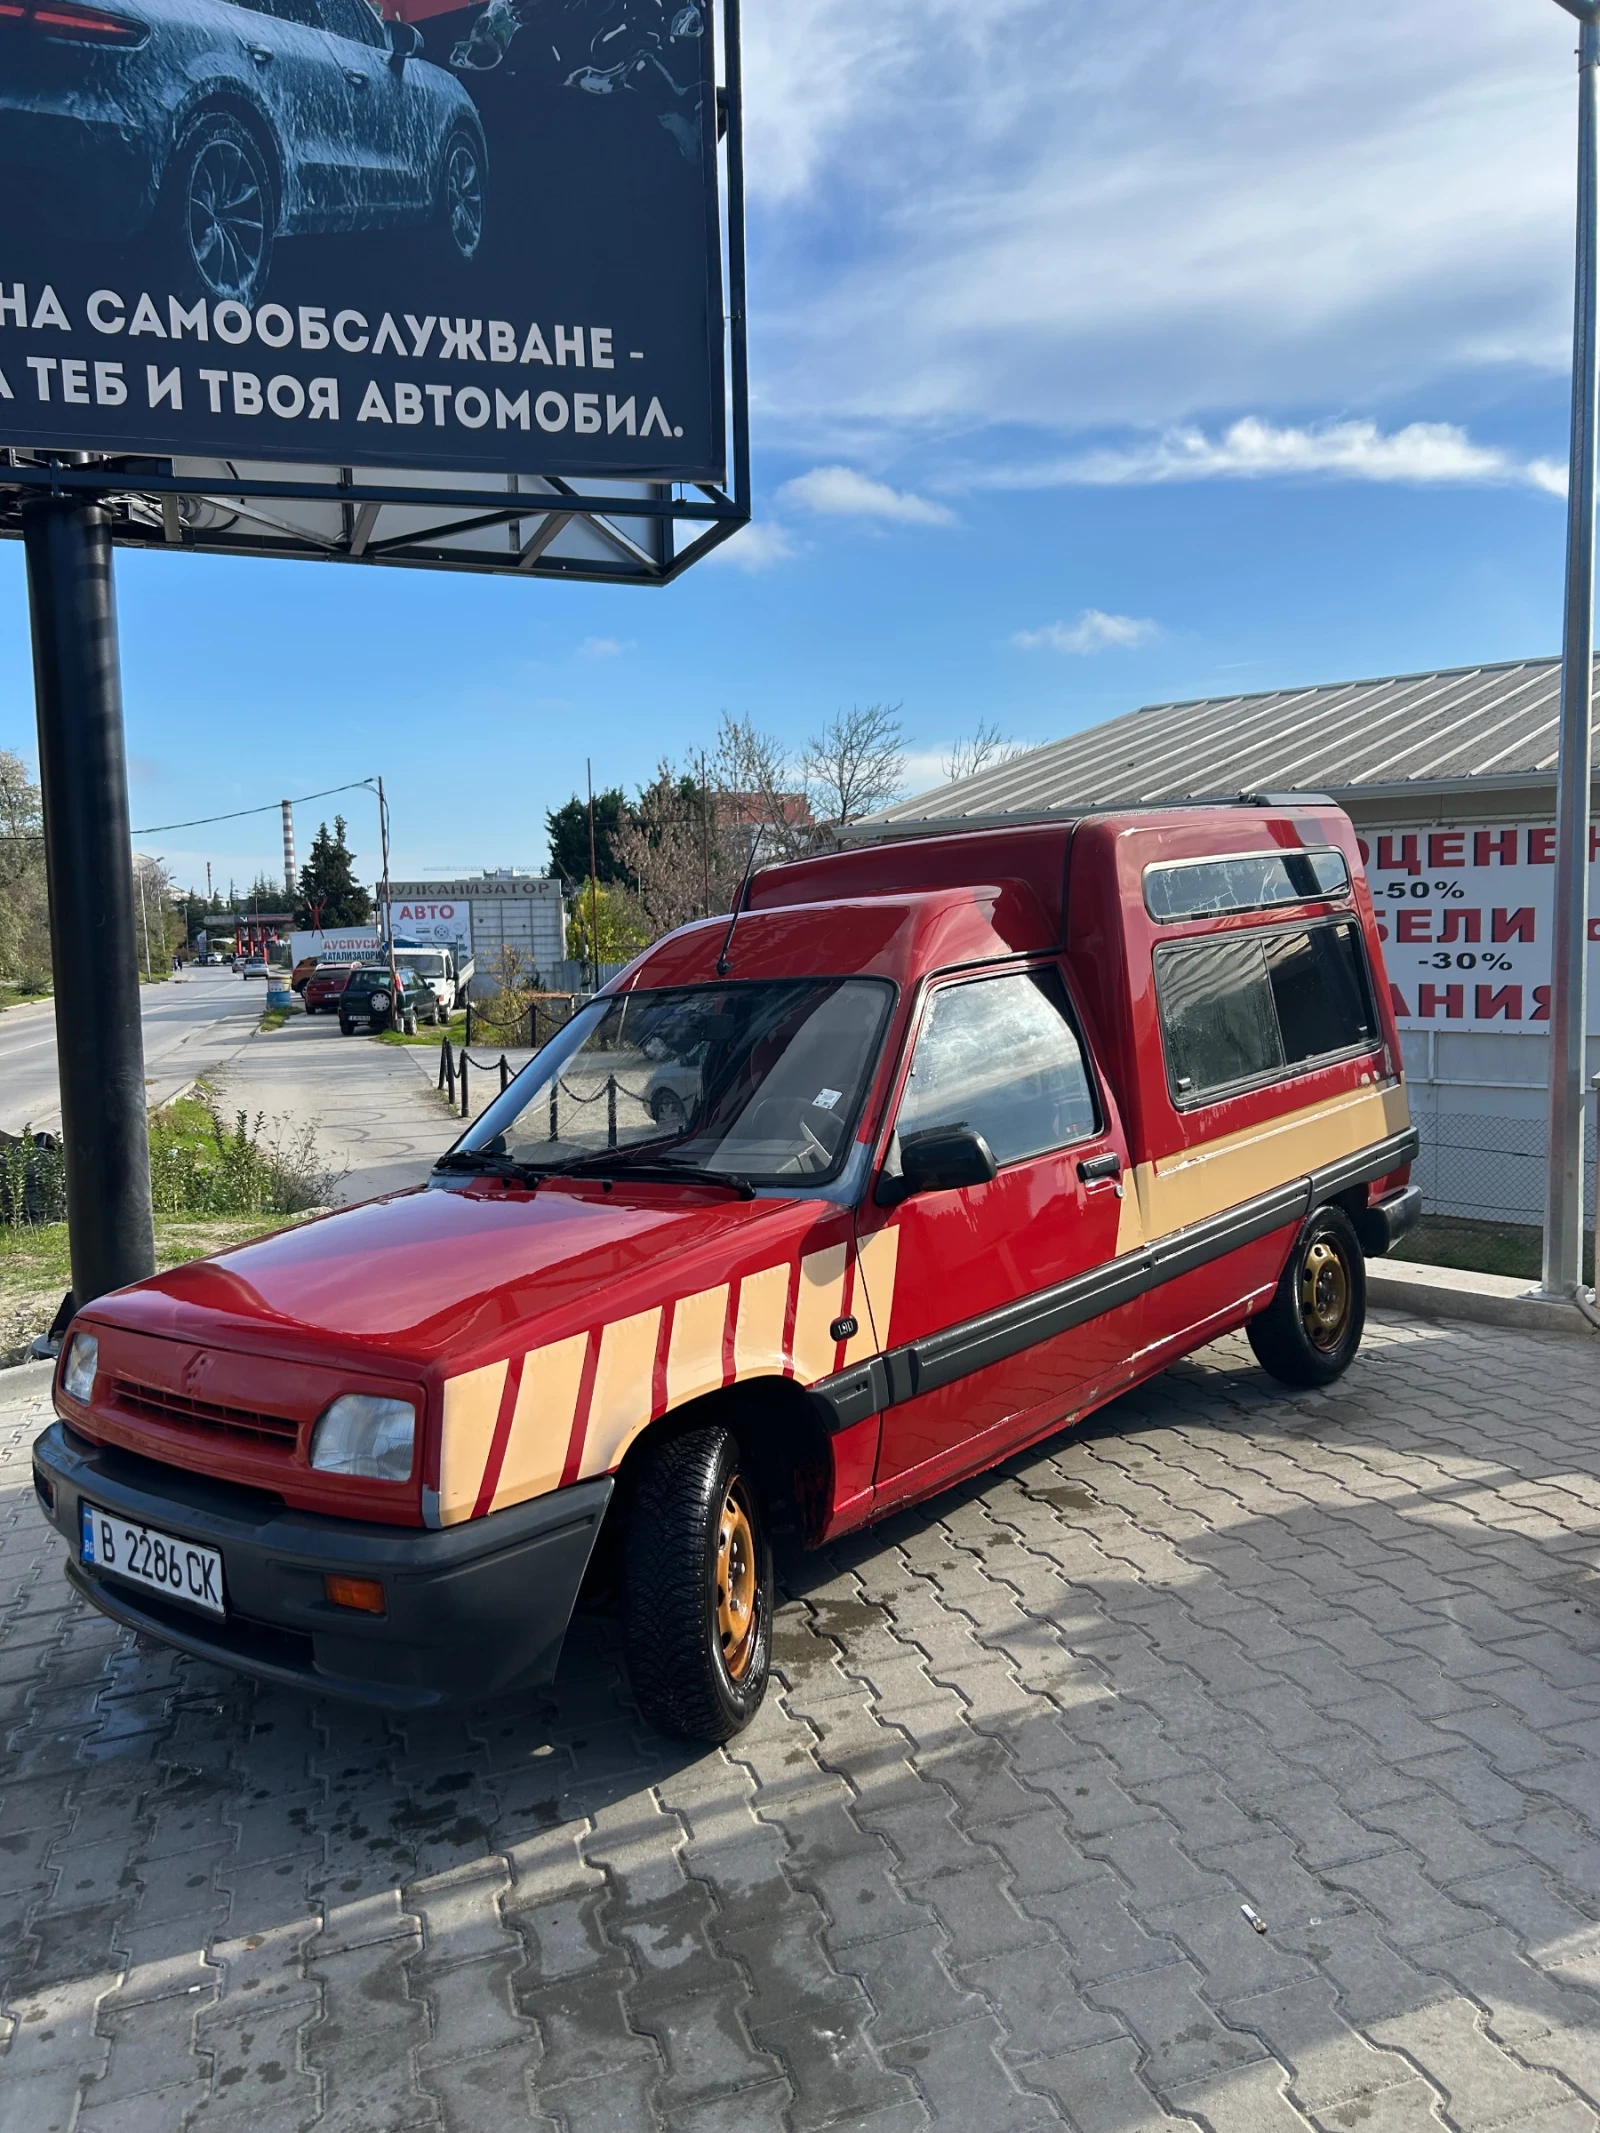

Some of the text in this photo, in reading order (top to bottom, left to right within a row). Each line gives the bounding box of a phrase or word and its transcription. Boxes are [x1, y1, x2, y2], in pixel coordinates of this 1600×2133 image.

[0, 282, 72, 331] НА
[86, 289, 615, 369] САМООБСЛУЖВАНЕ
[26, 356, 128, 406] ТЕБ
[146, 364, 183, 410] И
[199, 368, 340, 420] ТВОЯ
[356, 380, 684, 438] АВТОМОБИЛ.
[1356, 826, 1600, 876] ЦЕНЕ
[1373, 881, 1465, 899] -50%
[399, 904, 455, 920] АВТО
[324, 939, 380, 949] АУСПУСИ
[322, 951, 380, 960] КАТАЛИЗАТОРИ
[1418, 952, 1513, 971] -30%
